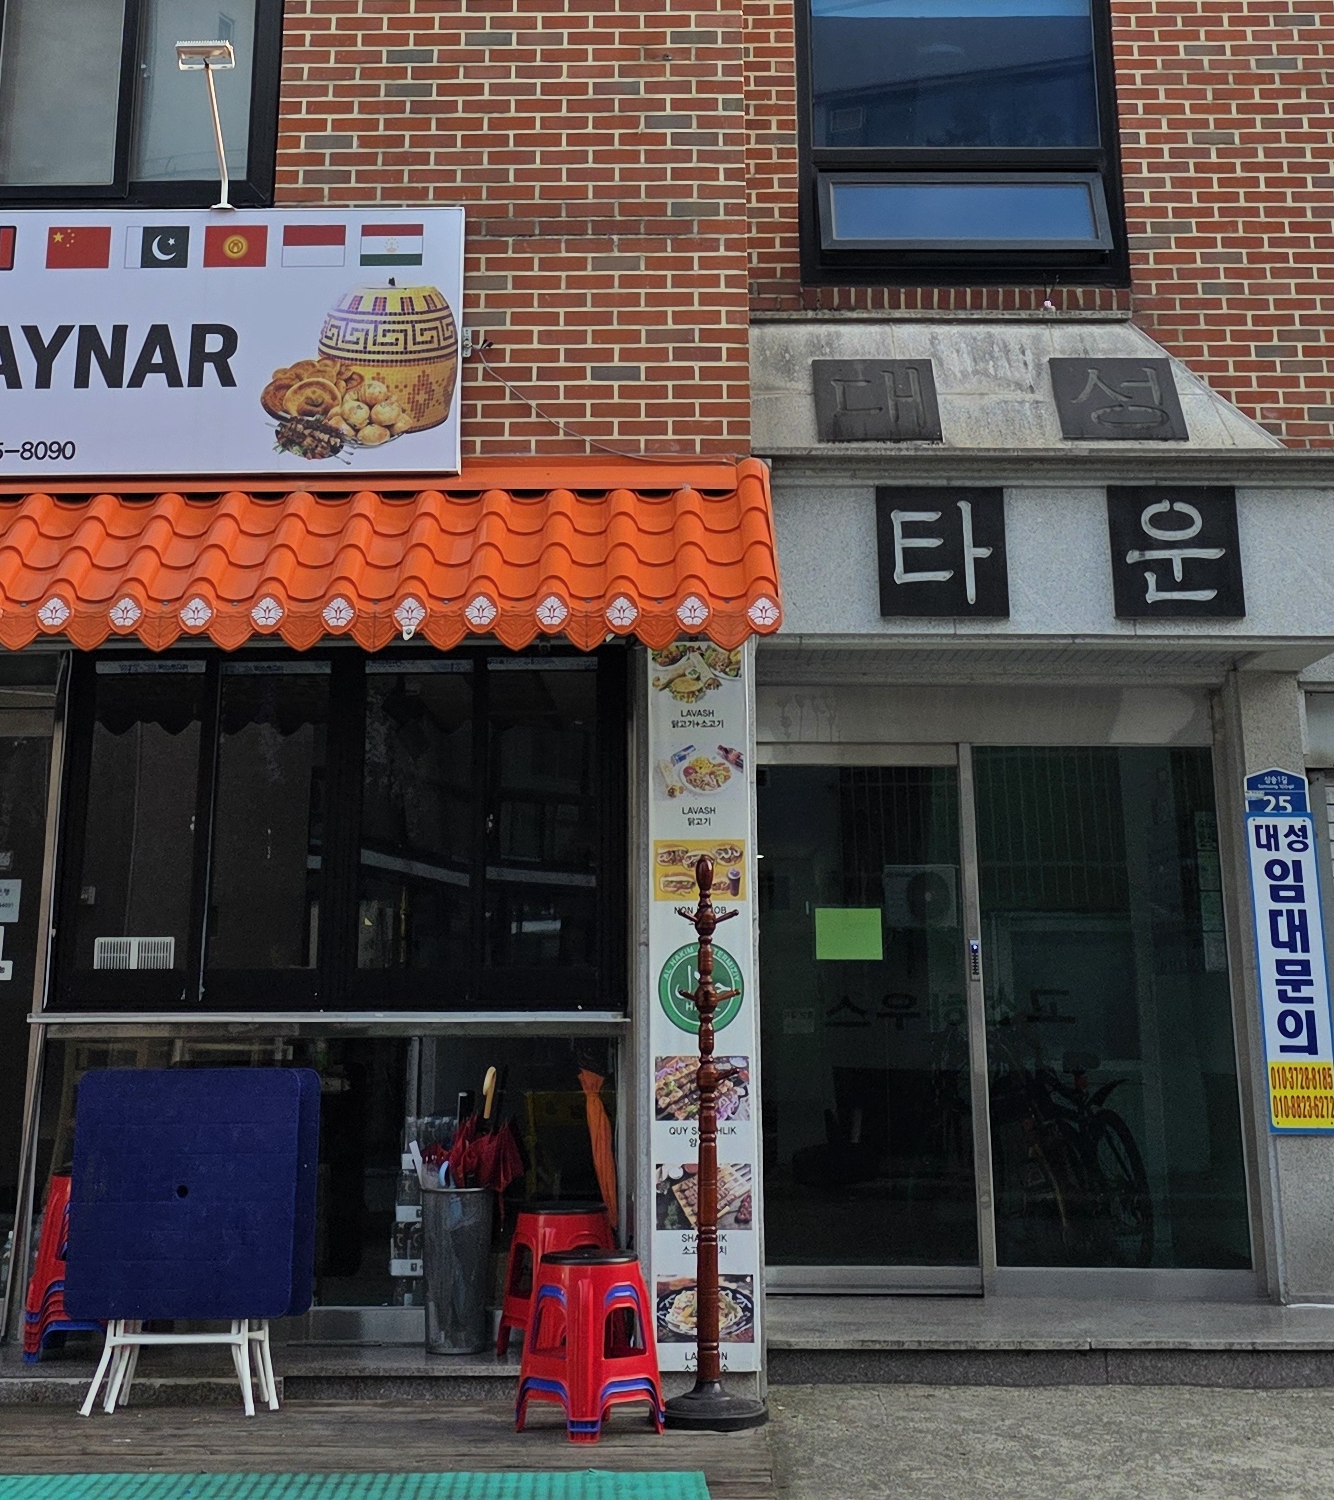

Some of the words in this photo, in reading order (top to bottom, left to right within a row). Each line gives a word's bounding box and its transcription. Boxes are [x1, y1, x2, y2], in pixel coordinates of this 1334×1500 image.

[890, 498, 1226, 605] 타운
[681, 709, 715, 717] LAVASH
[681, 806, 716, 815] LAVASH
[1263, 795, 1293, 813] 25
[687, 817, 711, 826] 닭고기
[1255, 824, 1310, 852] 대성
[663, 967, 672, 980] AL
[670, 946, 695, 967] HAKIM
[1264, 859, 1319, 1055] 임대문의
[1270, 1066, 1334, 1090] 010-3728-8185
[669, 1127, 688, 1135] QUY
[691, 1127, 737, 1135] SHLIK
[681, 1233, 728, 1242] SHAIK
